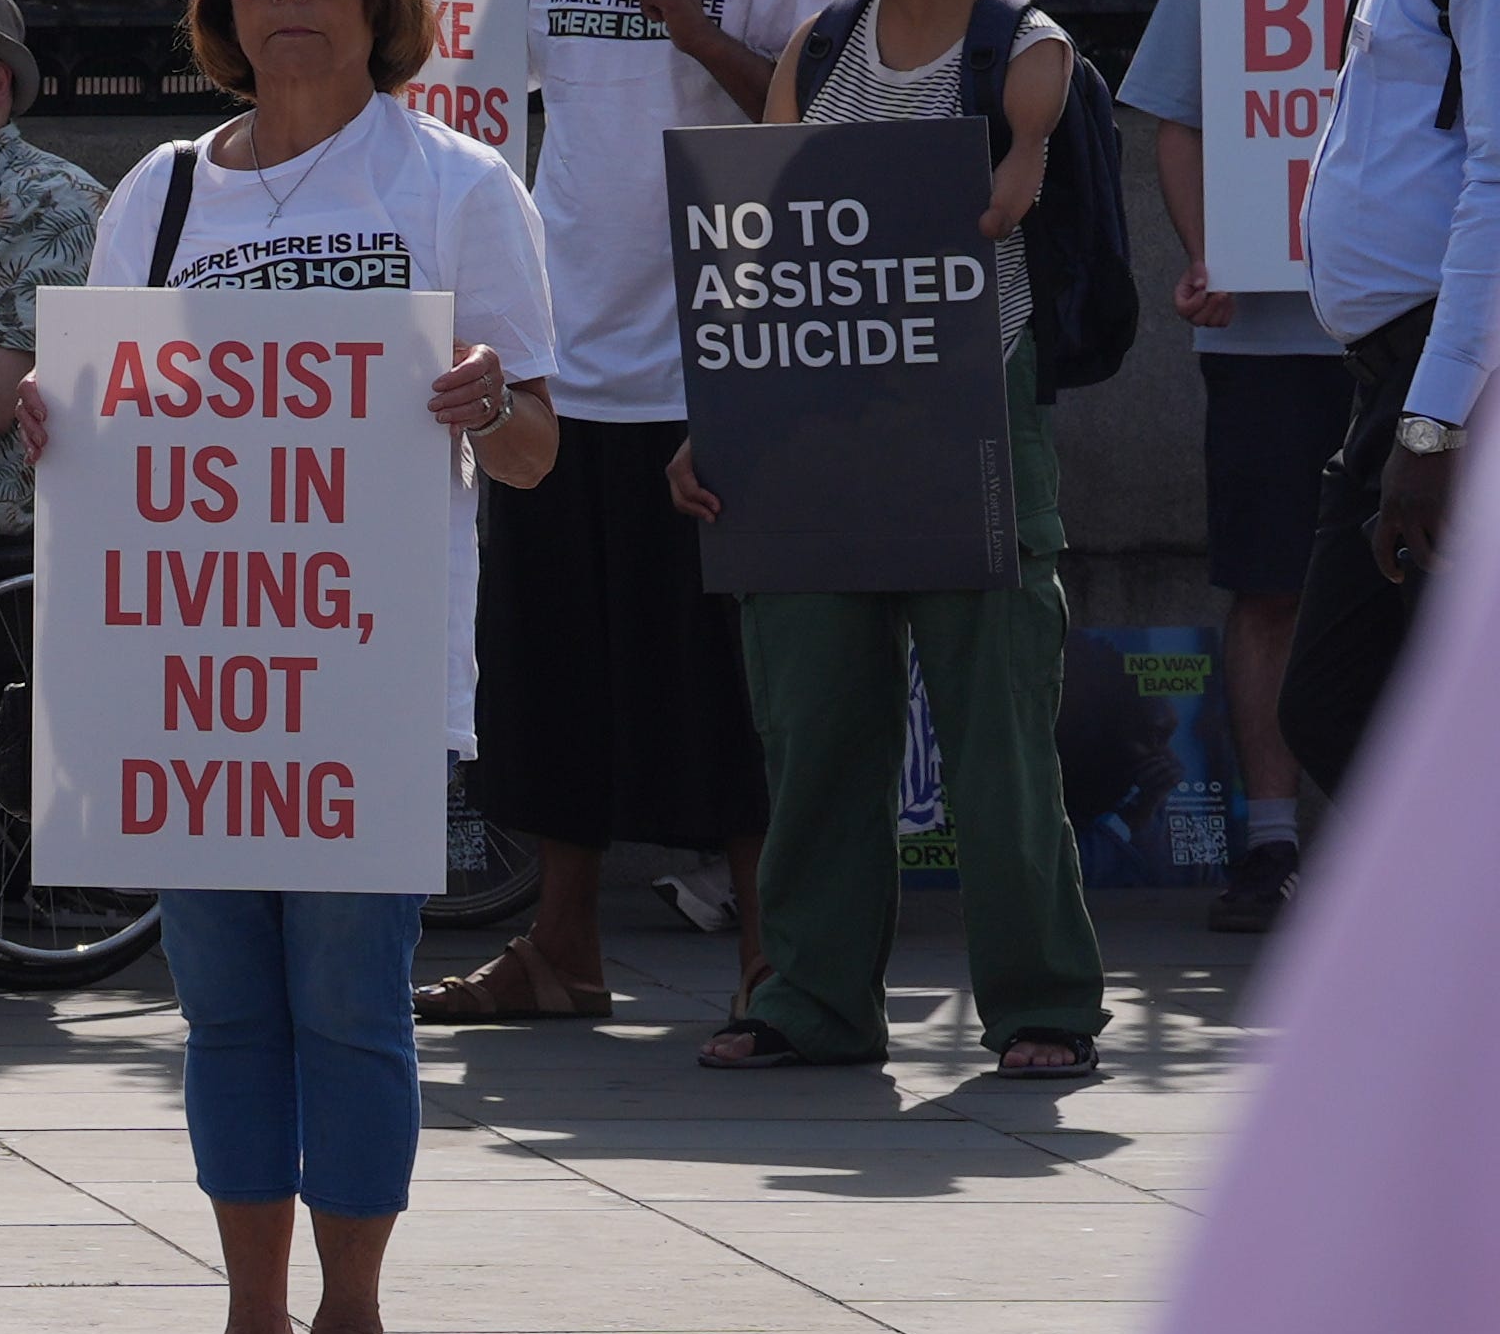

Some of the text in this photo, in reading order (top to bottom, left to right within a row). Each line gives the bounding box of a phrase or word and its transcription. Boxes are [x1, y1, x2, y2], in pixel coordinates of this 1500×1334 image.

[550, 13, 617, 37] THERE
[621, 17, 644, 38] IS
[406, 83, 509, 145] TORS
[686, 198, 870, 250] NO TO
[167, 232, 409, 288] WHERE THERE IS LIFE
[268, 263, 300, 290] IS
[306, 257, 407, 288] HOPE
[691, 255, 985, 310] ASSISTED
[695, 317, 939, 370] SUICIDE
[100, 340, 384, 420] ASSIST
[136, 445, 345, 524] US IN
[104, 550, 374, 644] LIVING,
[1129, 656, 1205, 673] NO WAY
[1143, 677, 1198, 692] BACK
[164, 655, 318, 733] NOT
[121, 759, 355, 839] DYING
